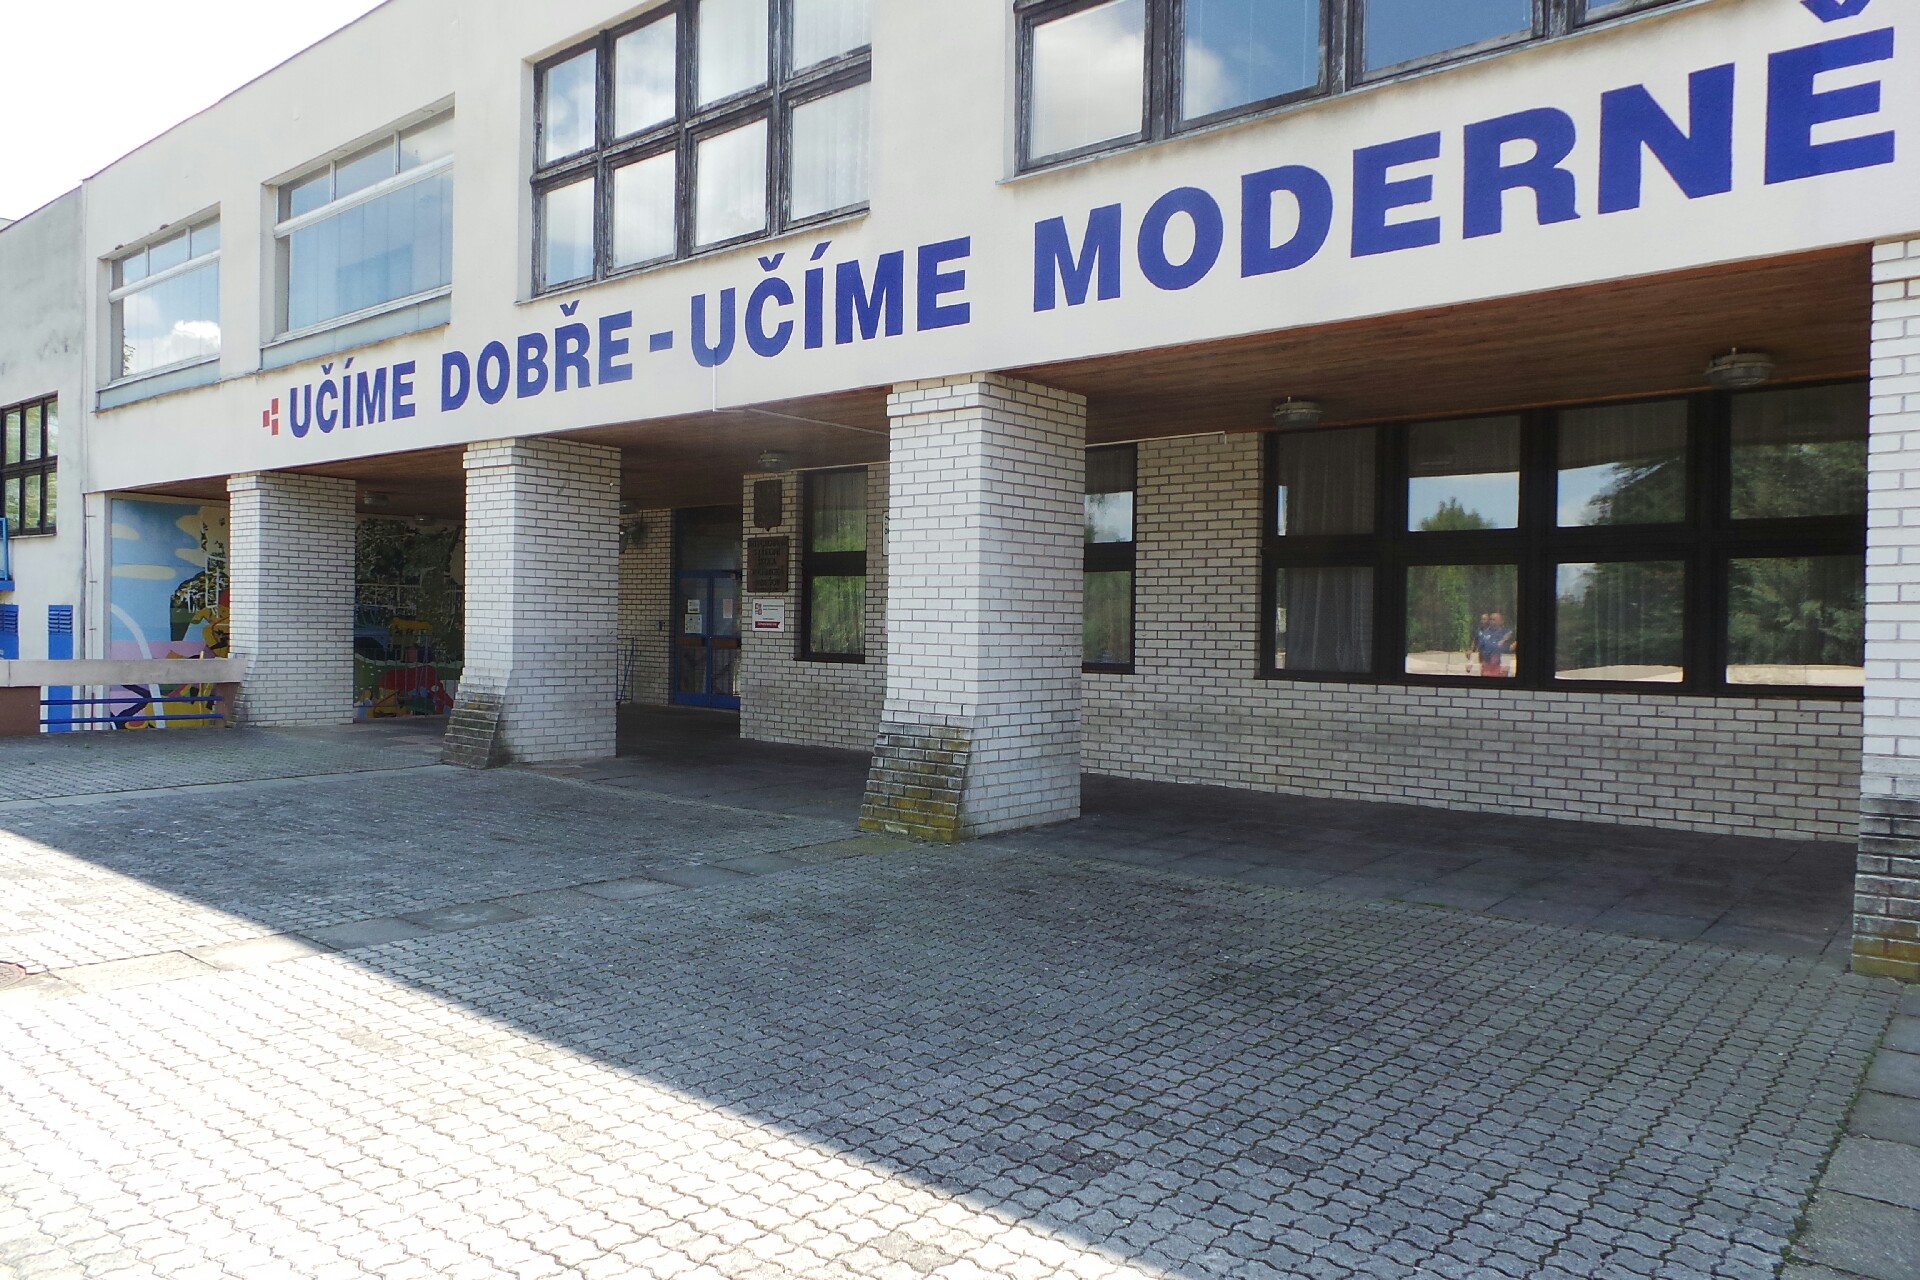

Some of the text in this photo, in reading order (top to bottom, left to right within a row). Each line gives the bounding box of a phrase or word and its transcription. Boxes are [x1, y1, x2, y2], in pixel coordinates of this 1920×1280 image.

[288, 357, 417, 438] UČÍME
[440, 300, 633, 412] DOBŘE
[690, 236, 971, 368] UČÍME
[1032, 0, 1896, 313] MODERNĚ
